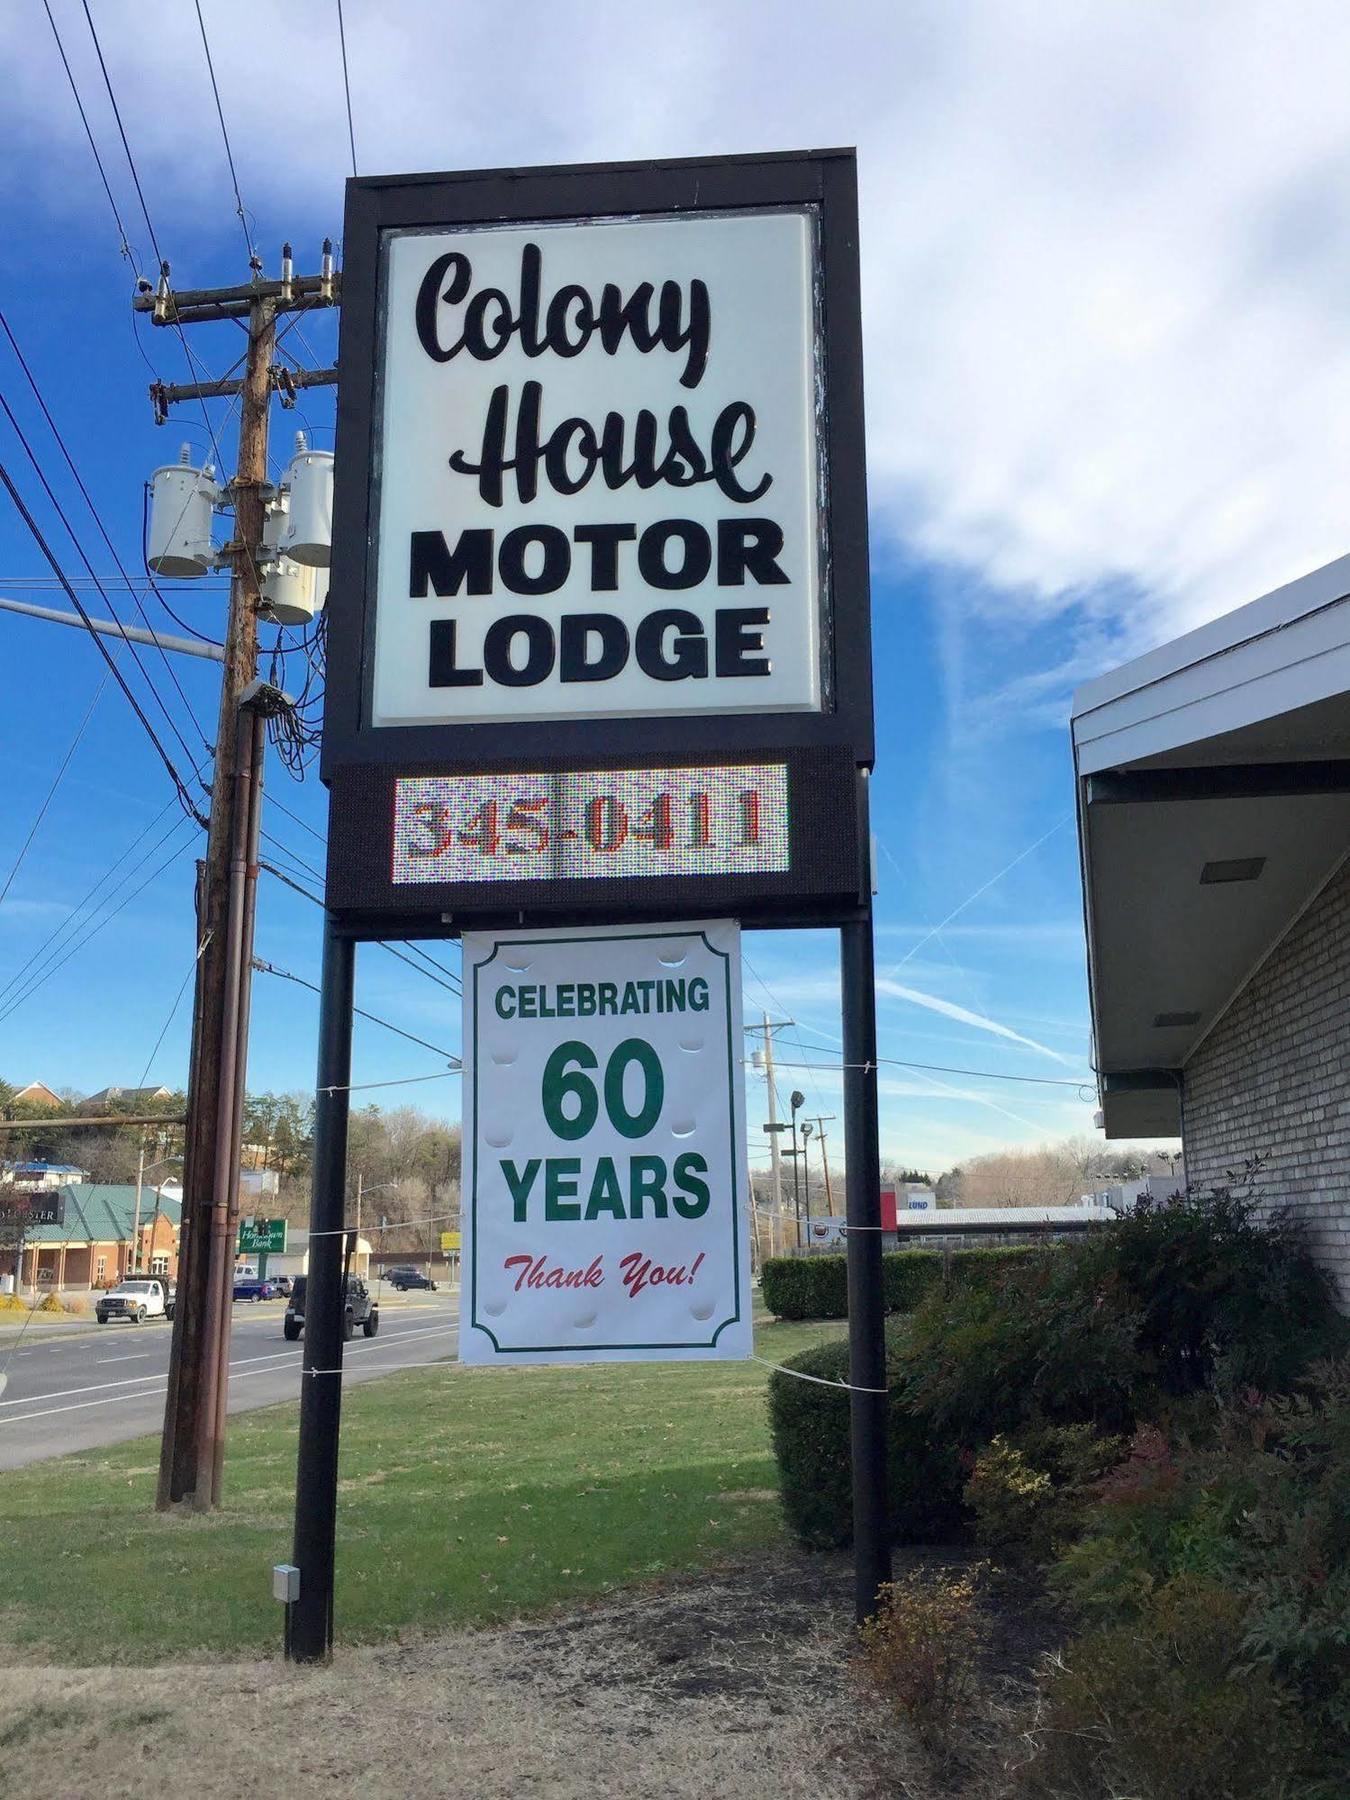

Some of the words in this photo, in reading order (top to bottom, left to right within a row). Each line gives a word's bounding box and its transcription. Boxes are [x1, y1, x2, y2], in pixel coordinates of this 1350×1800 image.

[416, 243, 711, 389] Colony
[449, 381, 773, 508] House
[410, 518, 791, 598] MOTOR
[429, 607, 772, 688] LODGE
[409, 790, 763, 859] 345-0411
[495, 977, 710, 1020] CELEBRATING
[541, 1037, 665, 1142] 60
[499, 1152, 711, 1223] YEARS
[909, 1201, 928, 1209] LUND
[252, 1239, 272, 1249] Bank
[504, 1254, 605, 1292] Thank
[620, 1252, 706, 1298] You!
